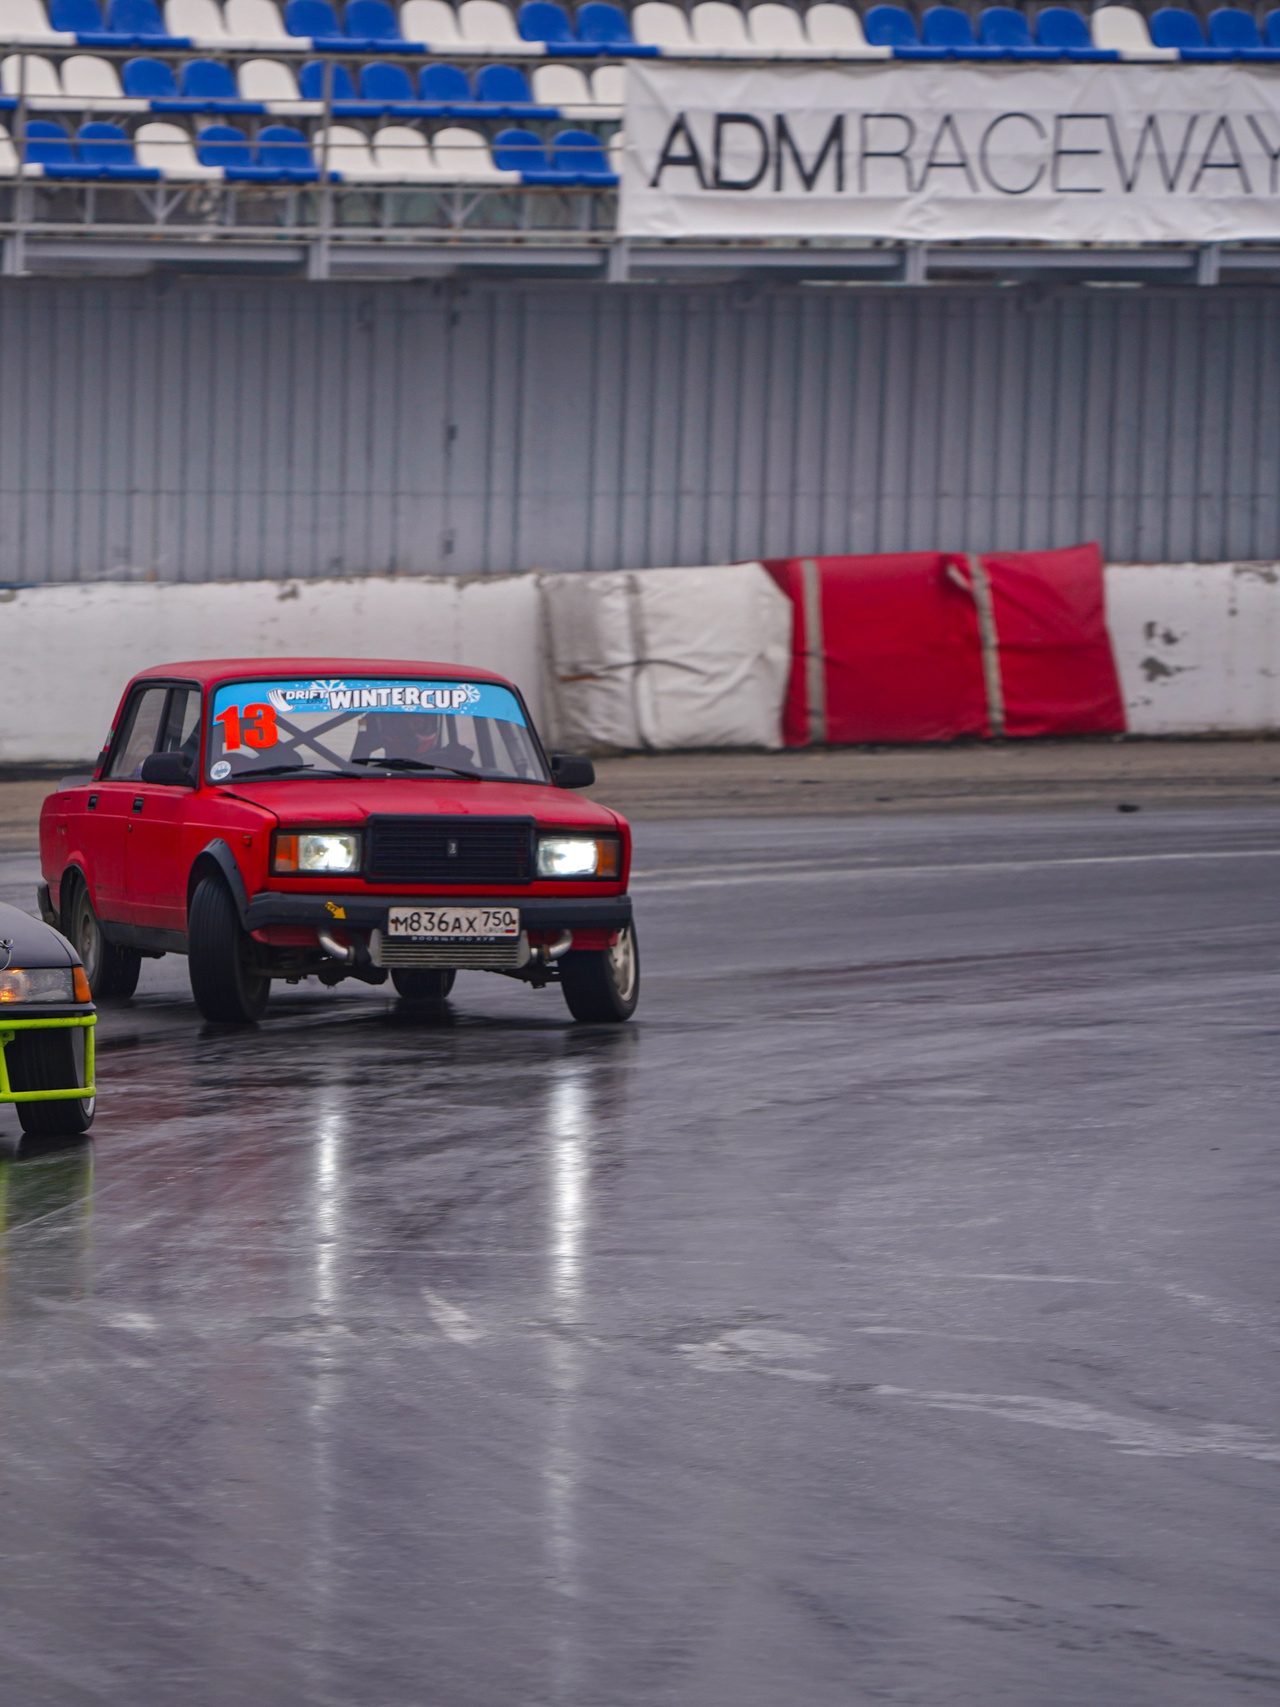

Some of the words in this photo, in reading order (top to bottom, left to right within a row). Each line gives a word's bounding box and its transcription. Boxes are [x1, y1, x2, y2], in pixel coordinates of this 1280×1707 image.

[285, 690, 326, 700] DRIFT
[215, 703, 278, 750] 13
[481, 911, 513, 927] 750
